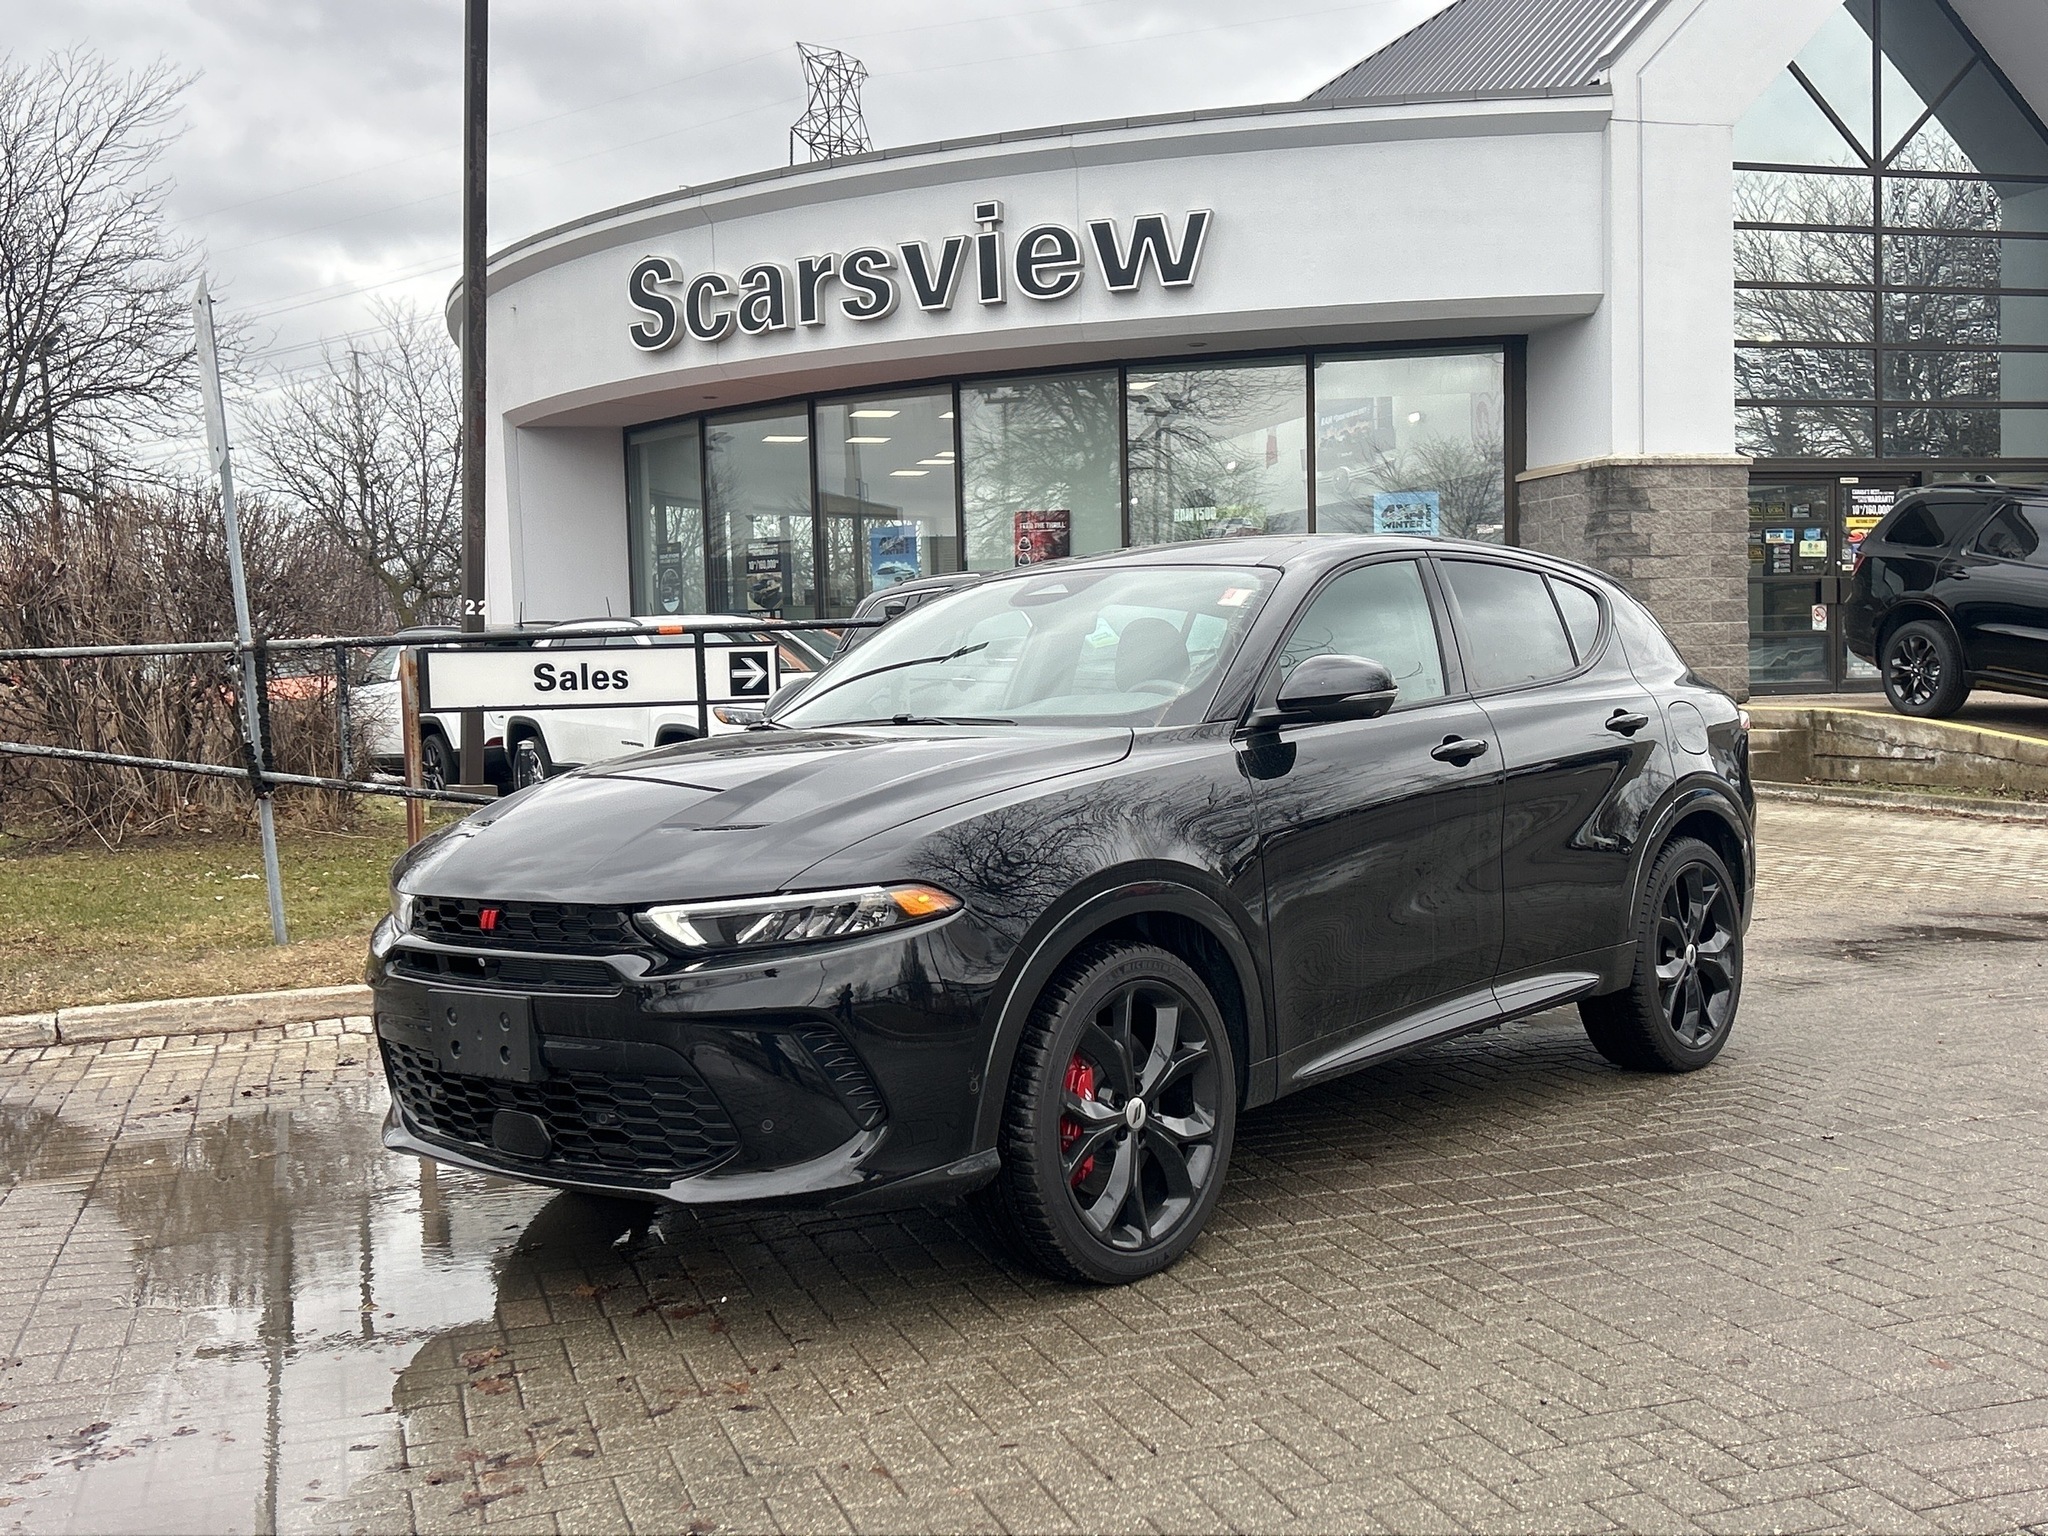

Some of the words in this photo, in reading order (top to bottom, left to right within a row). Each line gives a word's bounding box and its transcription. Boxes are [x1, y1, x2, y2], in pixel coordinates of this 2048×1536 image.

[628, 200, 1213, 352] Scarsview
[1174, 507, 1194, 522] RAM
[1195, 506, 1217, 521] 1500
[1381, 520, 1423, 529] WINTER
[533, 662, 629, 692] Sales
